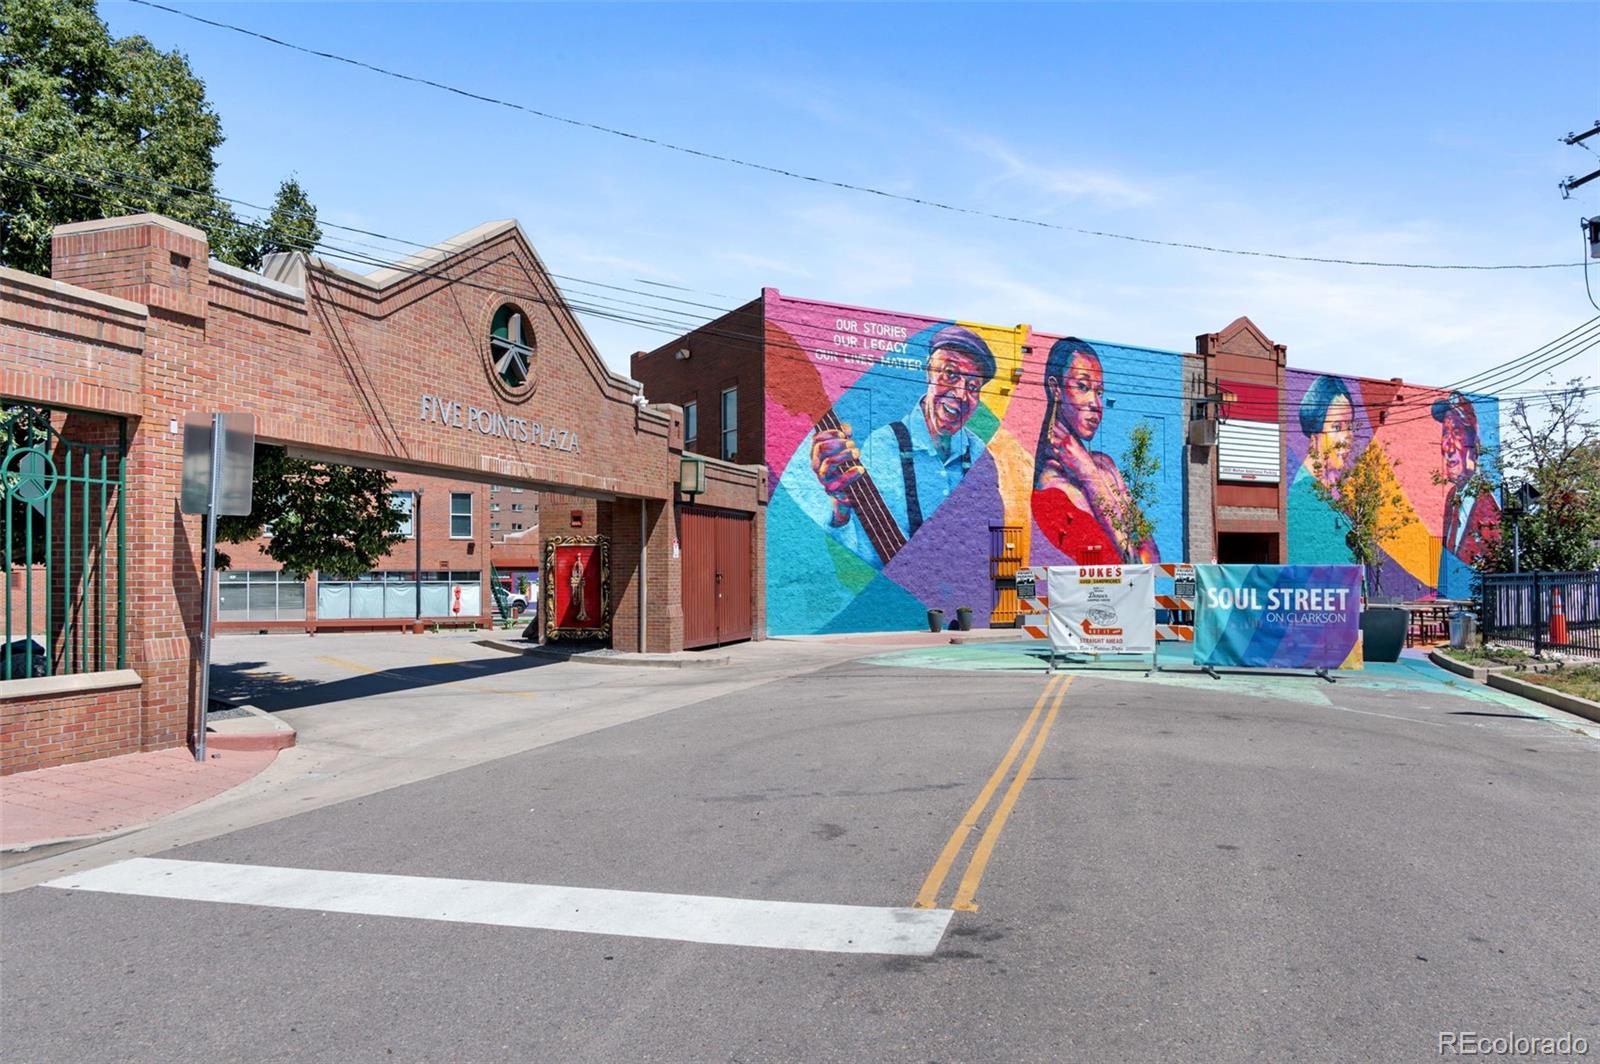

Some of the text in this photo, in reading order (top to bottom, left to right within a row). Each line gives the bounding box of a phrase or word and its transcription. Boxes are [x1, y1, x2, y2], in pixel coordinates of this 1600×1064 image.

[835, 319, 908, 338] OUR STORIES
[833, 335, 908, 354] OUR LEGACY
[815, 348, 839, 361] OUR
[880, 356, 922, 371] MATTER
[420, 394, 580, 455] FIVE POINTS PLAZA
[1079, 566, 1122, 578] DUKE'S
[1207, 587, 1262, 610] SOUL
[1267, 588, 1349, 611] STREET
[1266, 612, 1347, 624] ON CLARKSON
